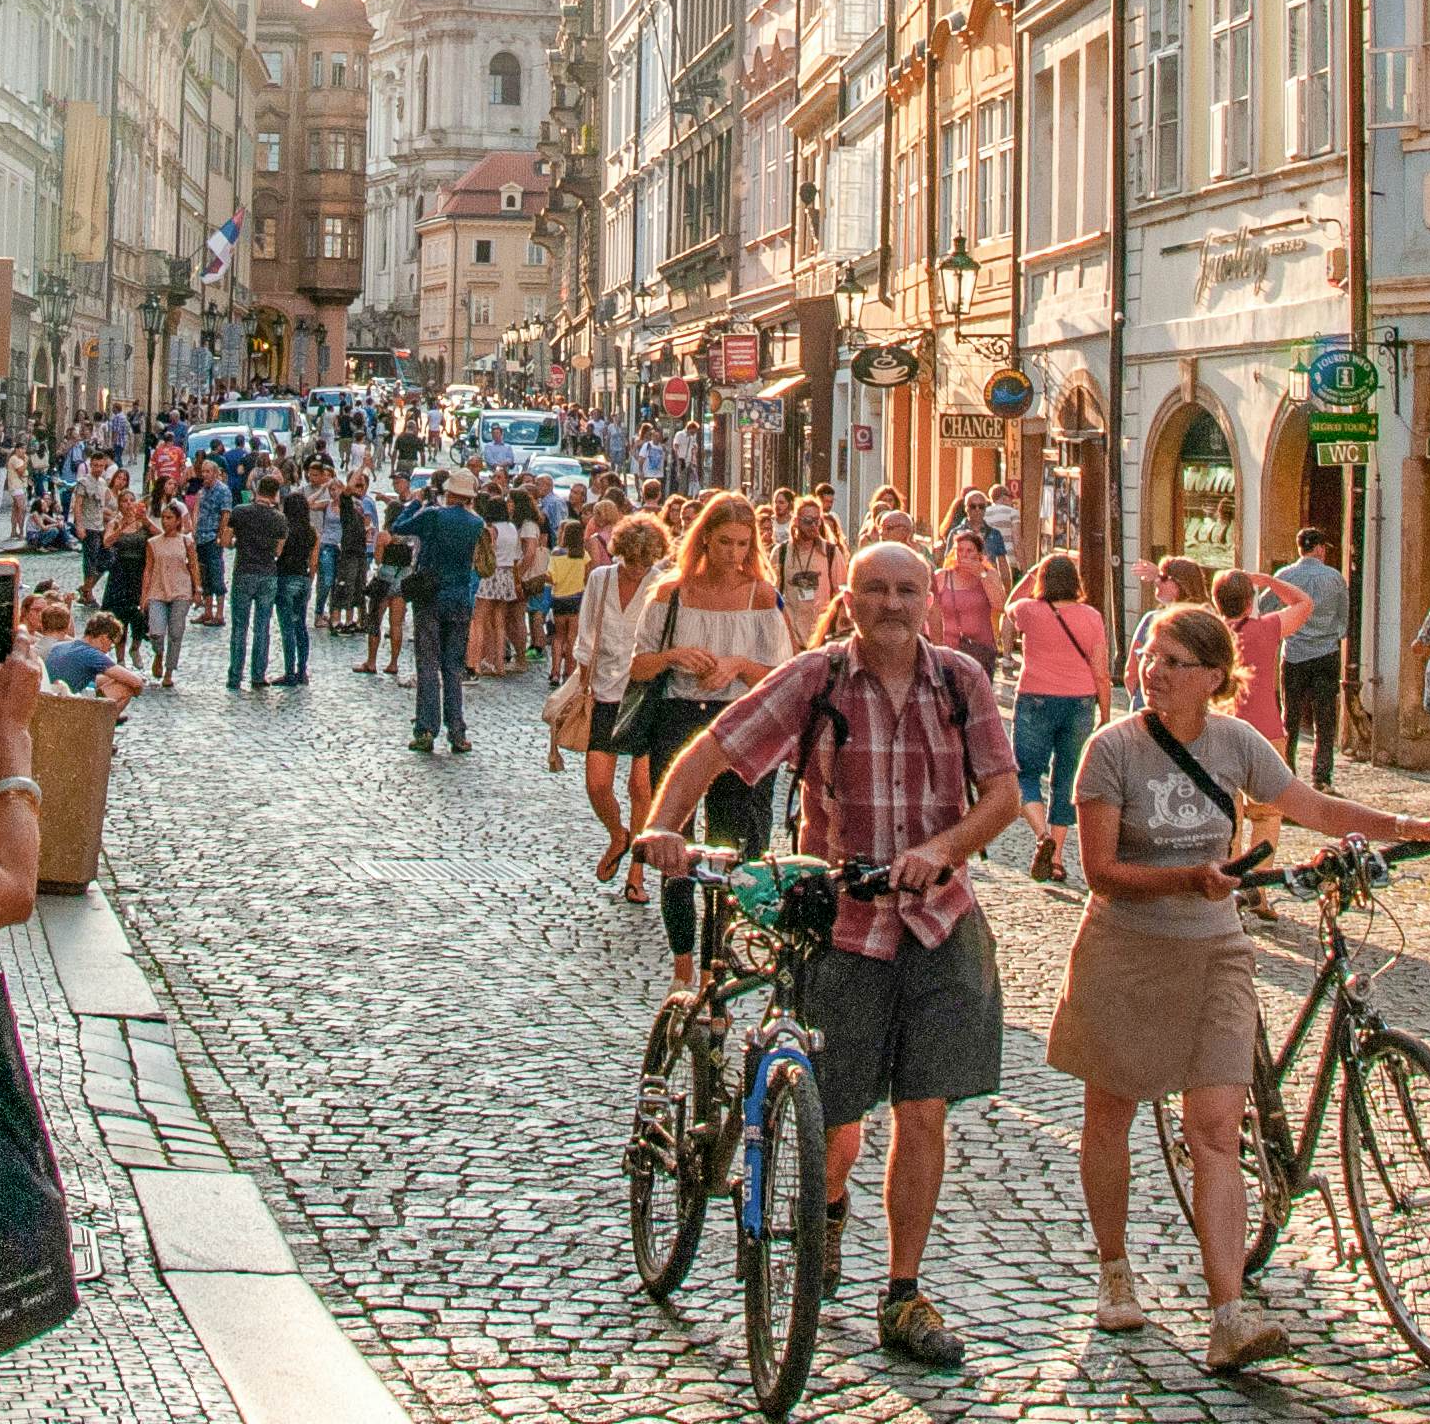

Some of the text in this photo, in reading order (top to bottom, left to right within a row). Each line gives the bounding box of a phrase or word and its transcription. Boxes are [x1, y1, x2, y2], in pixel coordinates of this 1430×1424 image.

[1317, 354, 1350, 370] TOURIST
[941, 416, 1003, 439] CHANGE
[1329, 445, 1359, 462] WC
